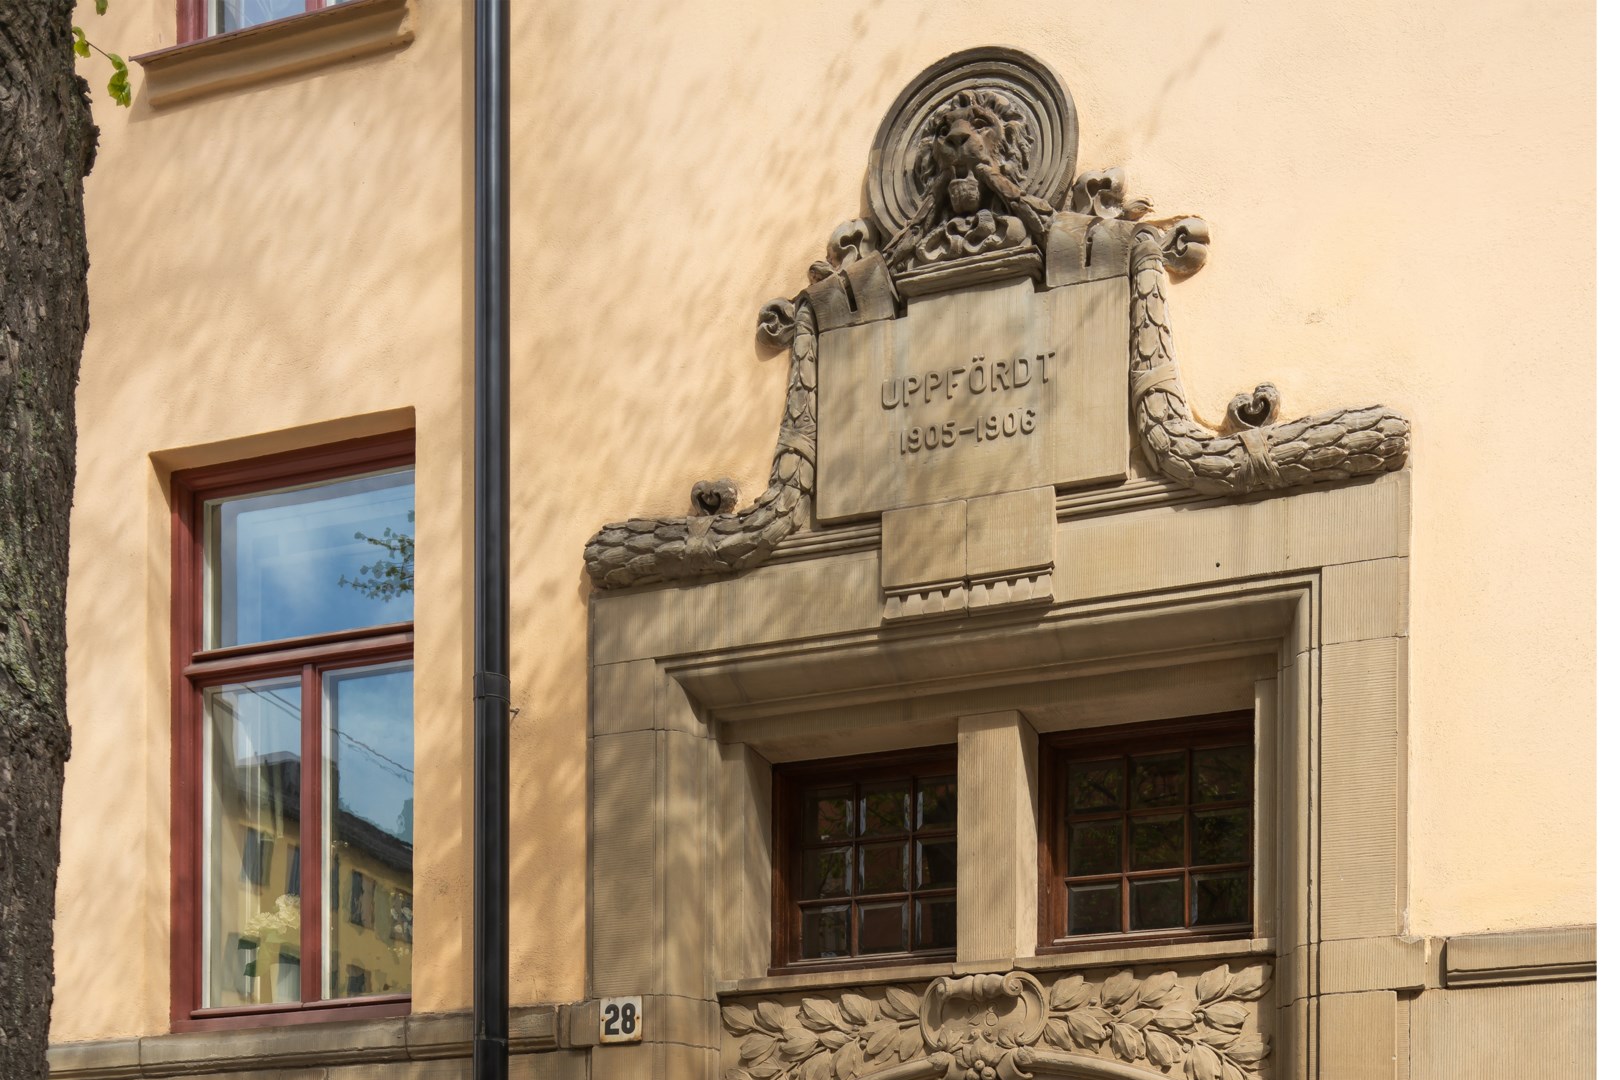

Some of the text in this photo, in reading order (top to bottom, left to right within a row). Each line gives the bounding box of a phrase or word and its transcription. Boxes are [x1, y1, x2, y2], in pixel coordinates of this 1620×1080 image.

[880, 352, 1056, 410] UPPFÖRDT
[900, 408, 1037, 455] 1905-1906
[605, 1003, 636, 1035] 28
